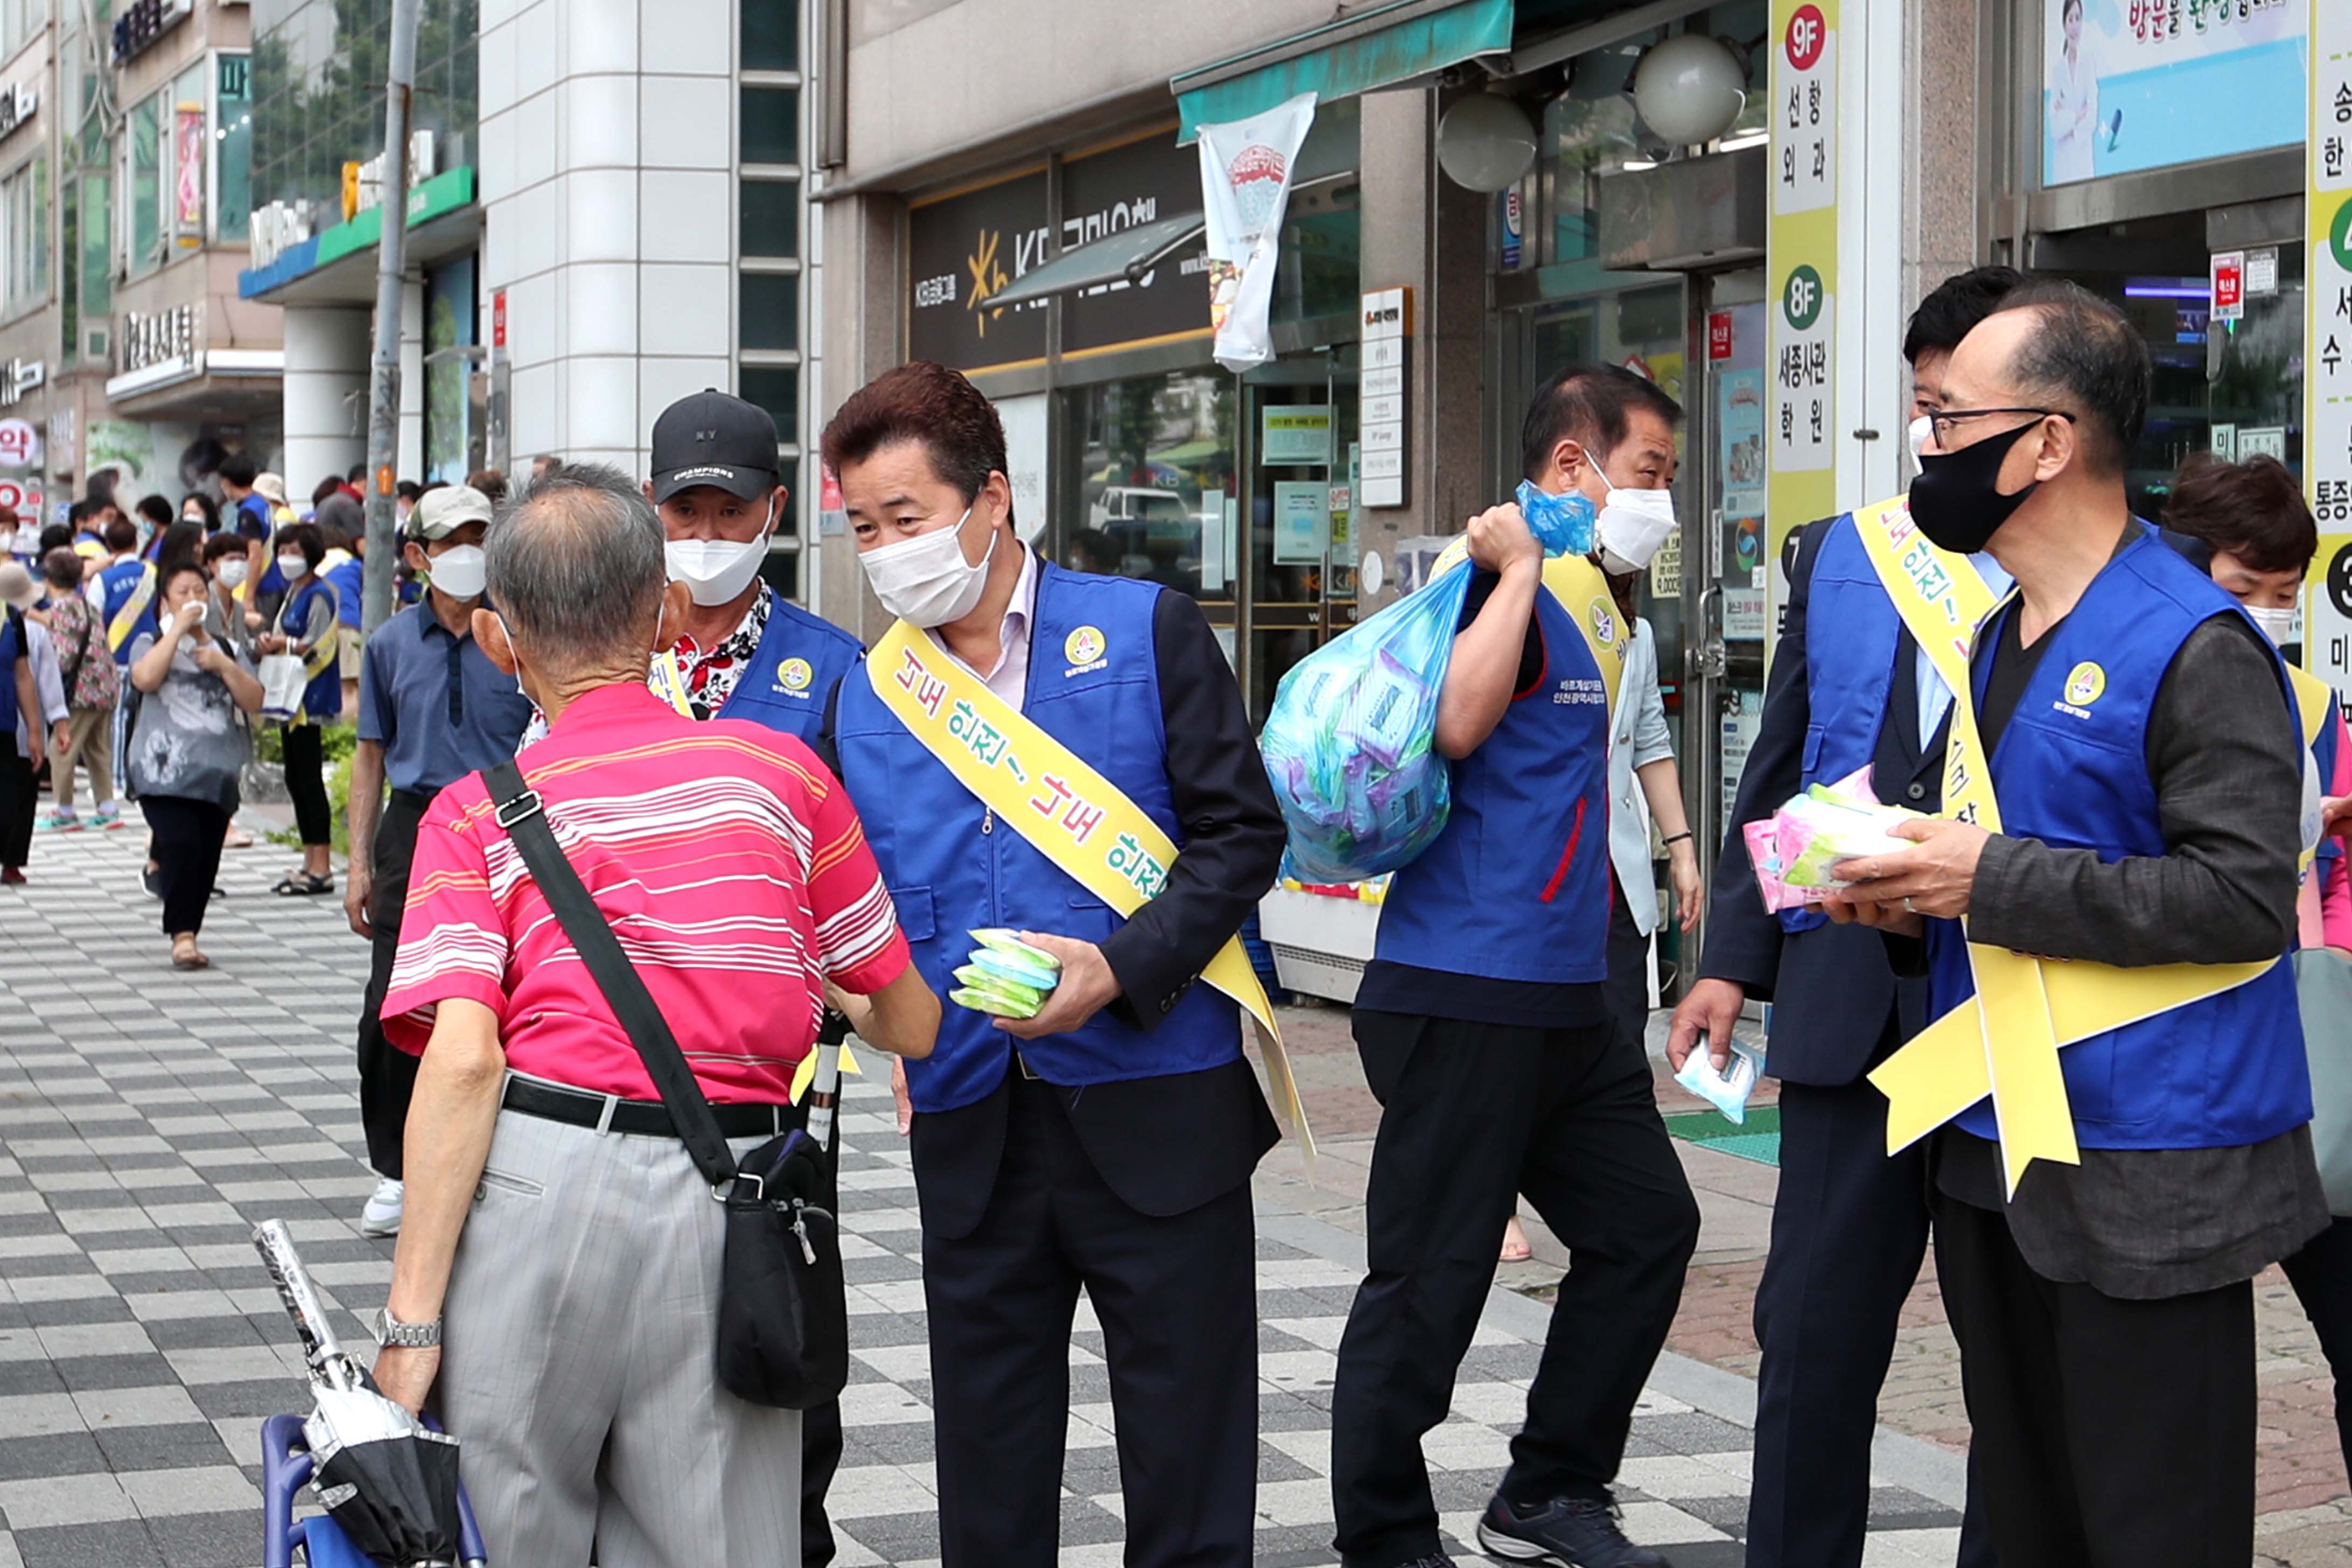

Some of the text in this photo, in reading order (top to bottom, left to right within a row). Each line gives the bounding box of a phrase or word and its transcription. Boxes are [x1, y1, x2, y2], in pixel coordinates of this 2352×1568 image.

[1792, 17, 1818, 58] 9F
[1789, 279, 1815, 318] 8F
[1779, 340, 1826, 389] 세종사관
[674, 467, 734, 481] CHAMPIONS
[2315, 480, 2352, 521] 통증
[1789, 537, 1800, 575] 7
[895, 649, 1168, 899] 너도 안전! 나도 안전
